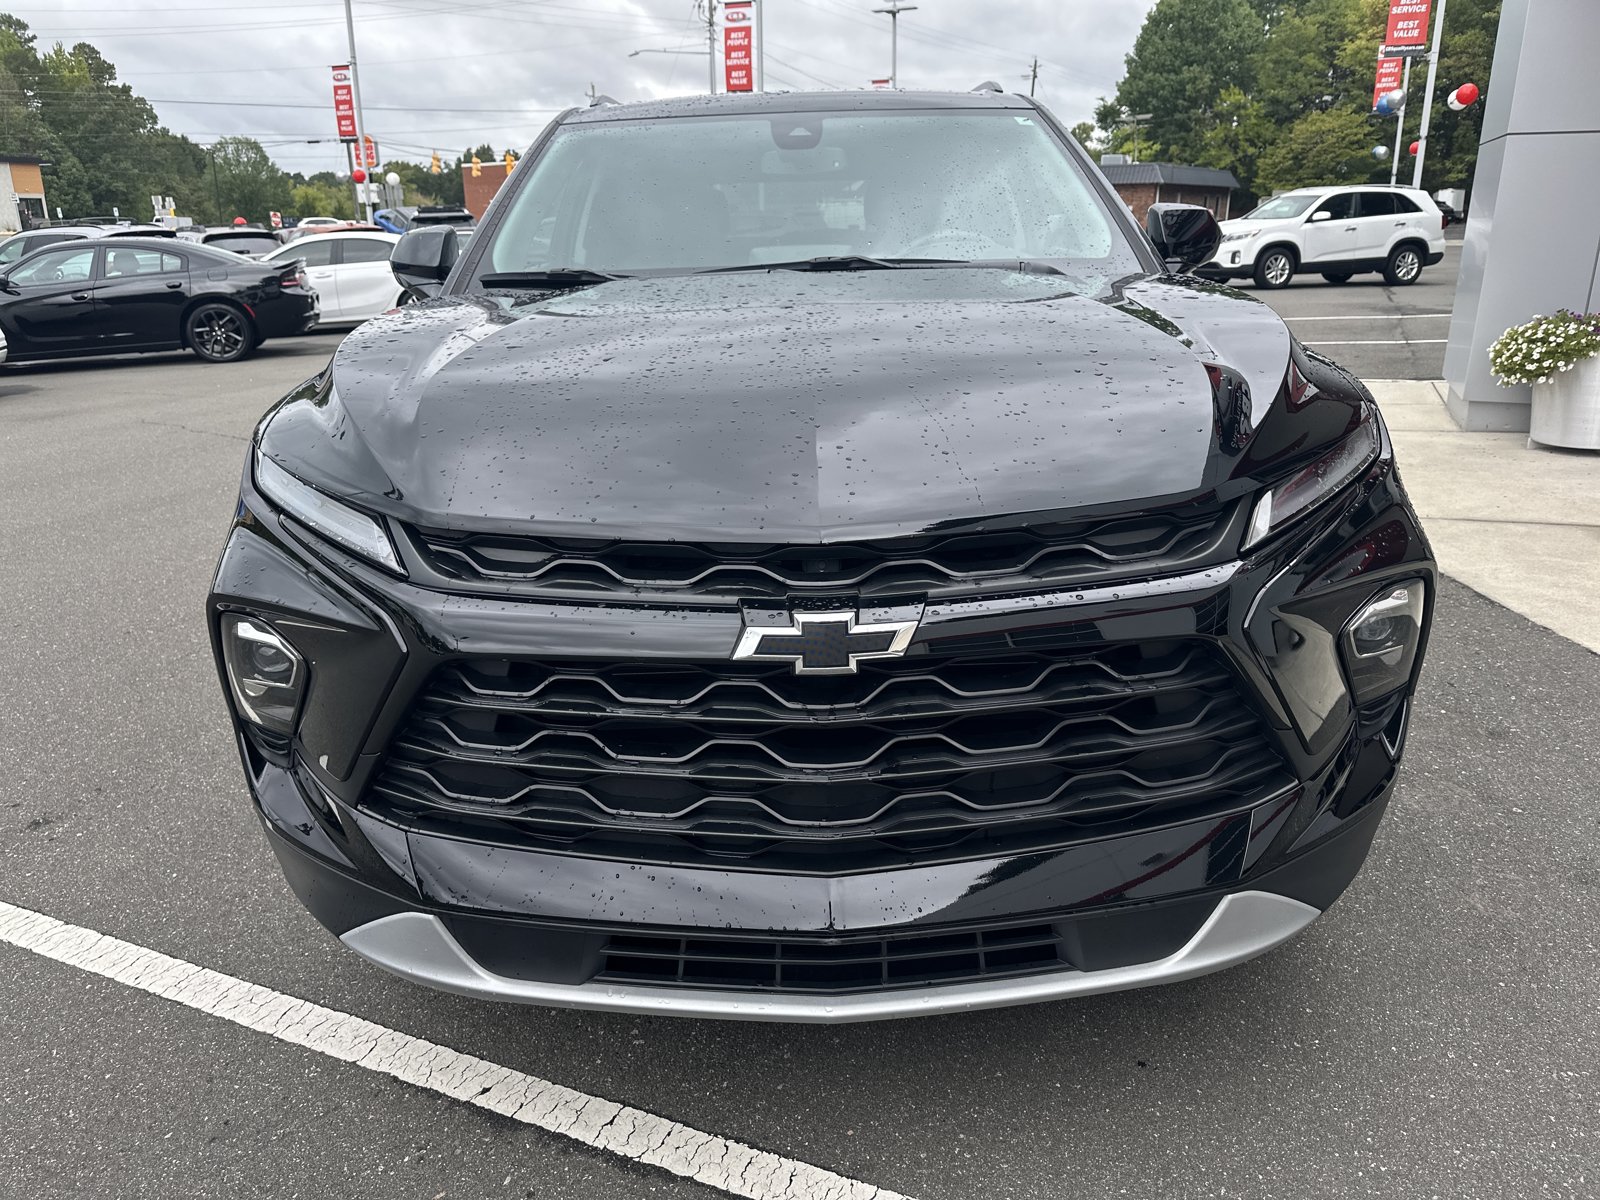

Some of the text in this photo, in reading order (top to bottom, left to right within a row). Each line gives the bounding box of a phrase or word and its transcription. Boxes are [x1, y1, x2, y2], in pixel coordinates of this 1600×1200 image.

[1391, 4, 1427, 14] SERVICE
[1397, 20, 1419, 29] BEST
[730, 31, 745, 39] BEST
[1393, 29, 1420, 38] VALUE
[726, 38, 749, 46] PEOPLE
[726, 58, 750, 66] SERVICE
[731, 70, 746, 78] BEST
